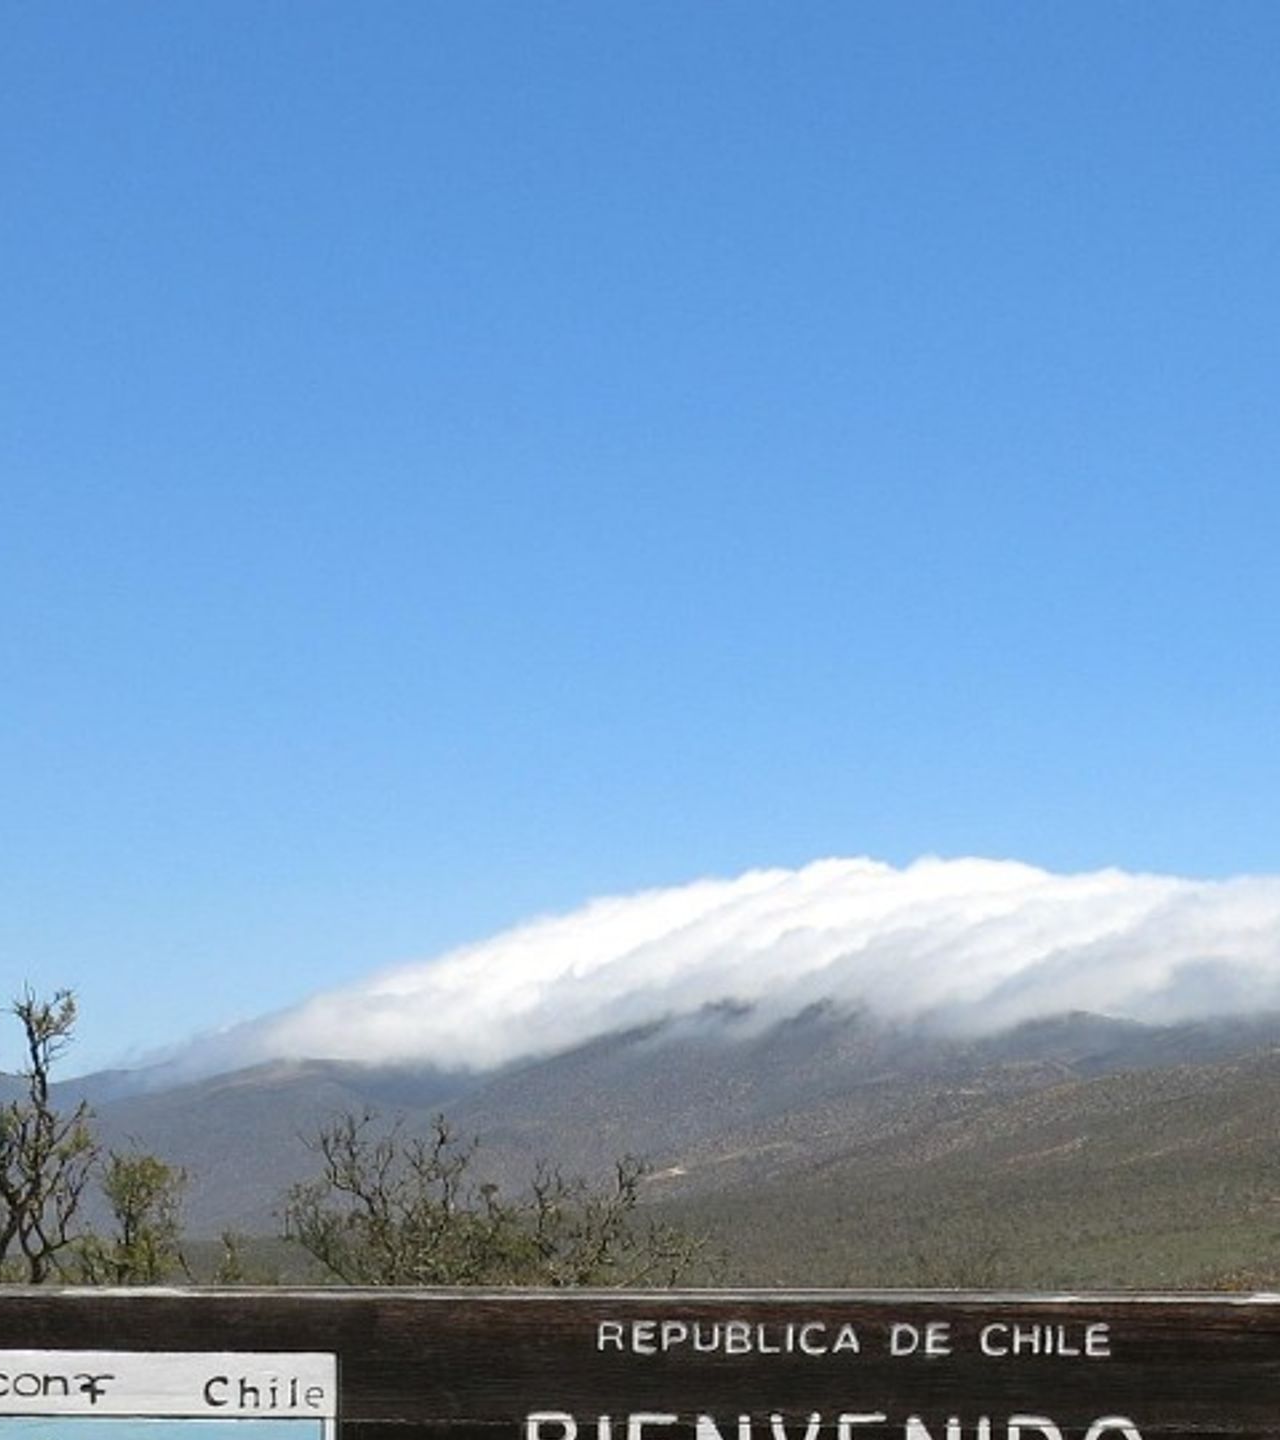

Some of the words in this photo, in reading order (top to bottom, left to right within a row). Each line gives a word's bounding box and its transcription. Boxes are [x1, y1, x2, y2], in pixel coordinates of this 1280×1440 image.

[597, 1320, 860, 1357] REPUBLICA
[890, 1321, 951, 1357] DE
[980, 1321, 1111, 1358] CHILE
[204, 1376, 324, 1408] Chile
